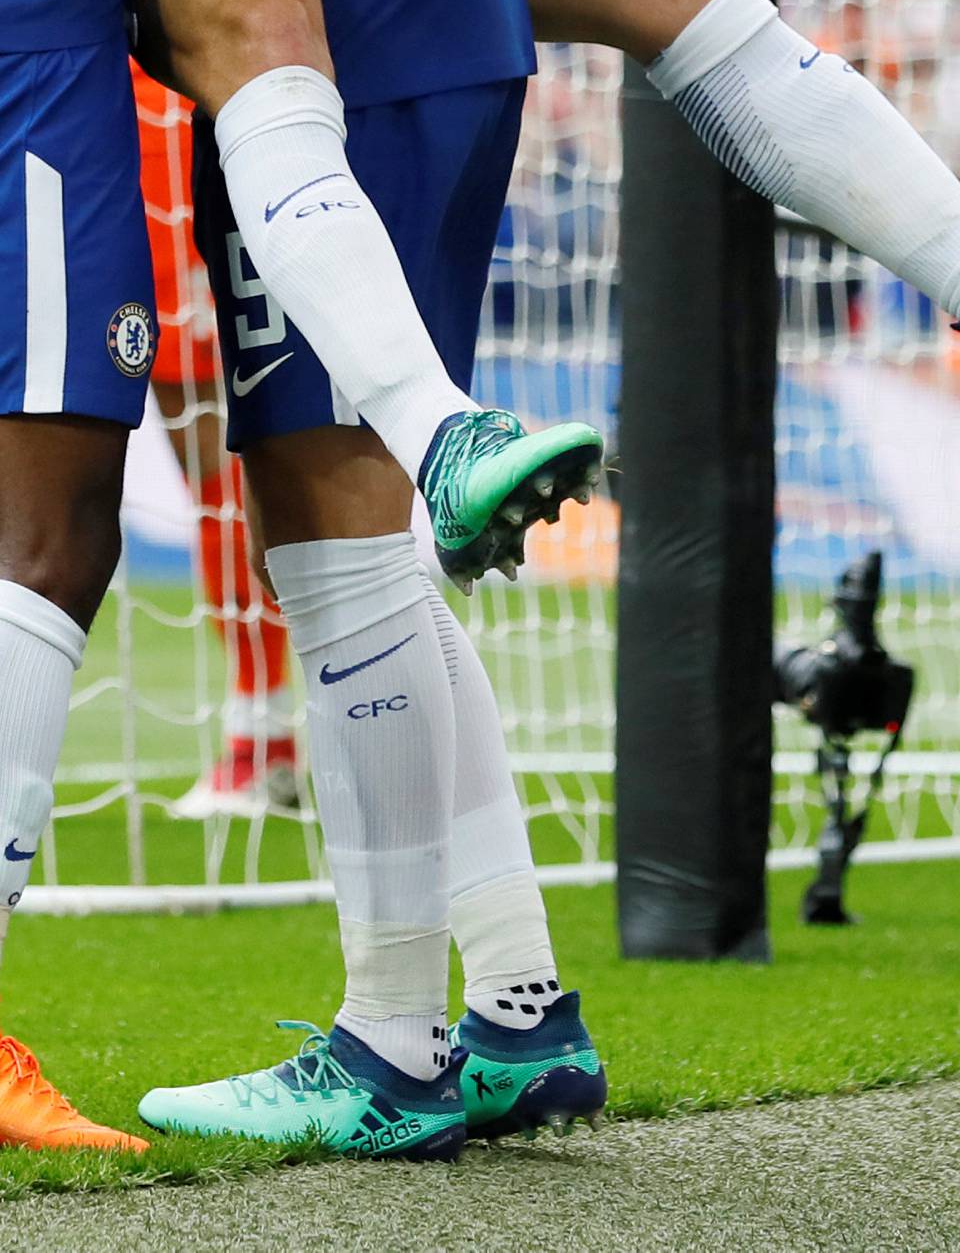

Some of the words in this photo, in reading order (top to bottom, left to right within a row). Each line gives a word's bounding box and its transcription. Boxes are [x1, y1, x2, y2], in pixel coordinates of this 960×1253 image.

[295, 200, 361, 218] CFC
[119, 306, 150, 325] CHELSEA
[346, 695, 409, 720] CFC
